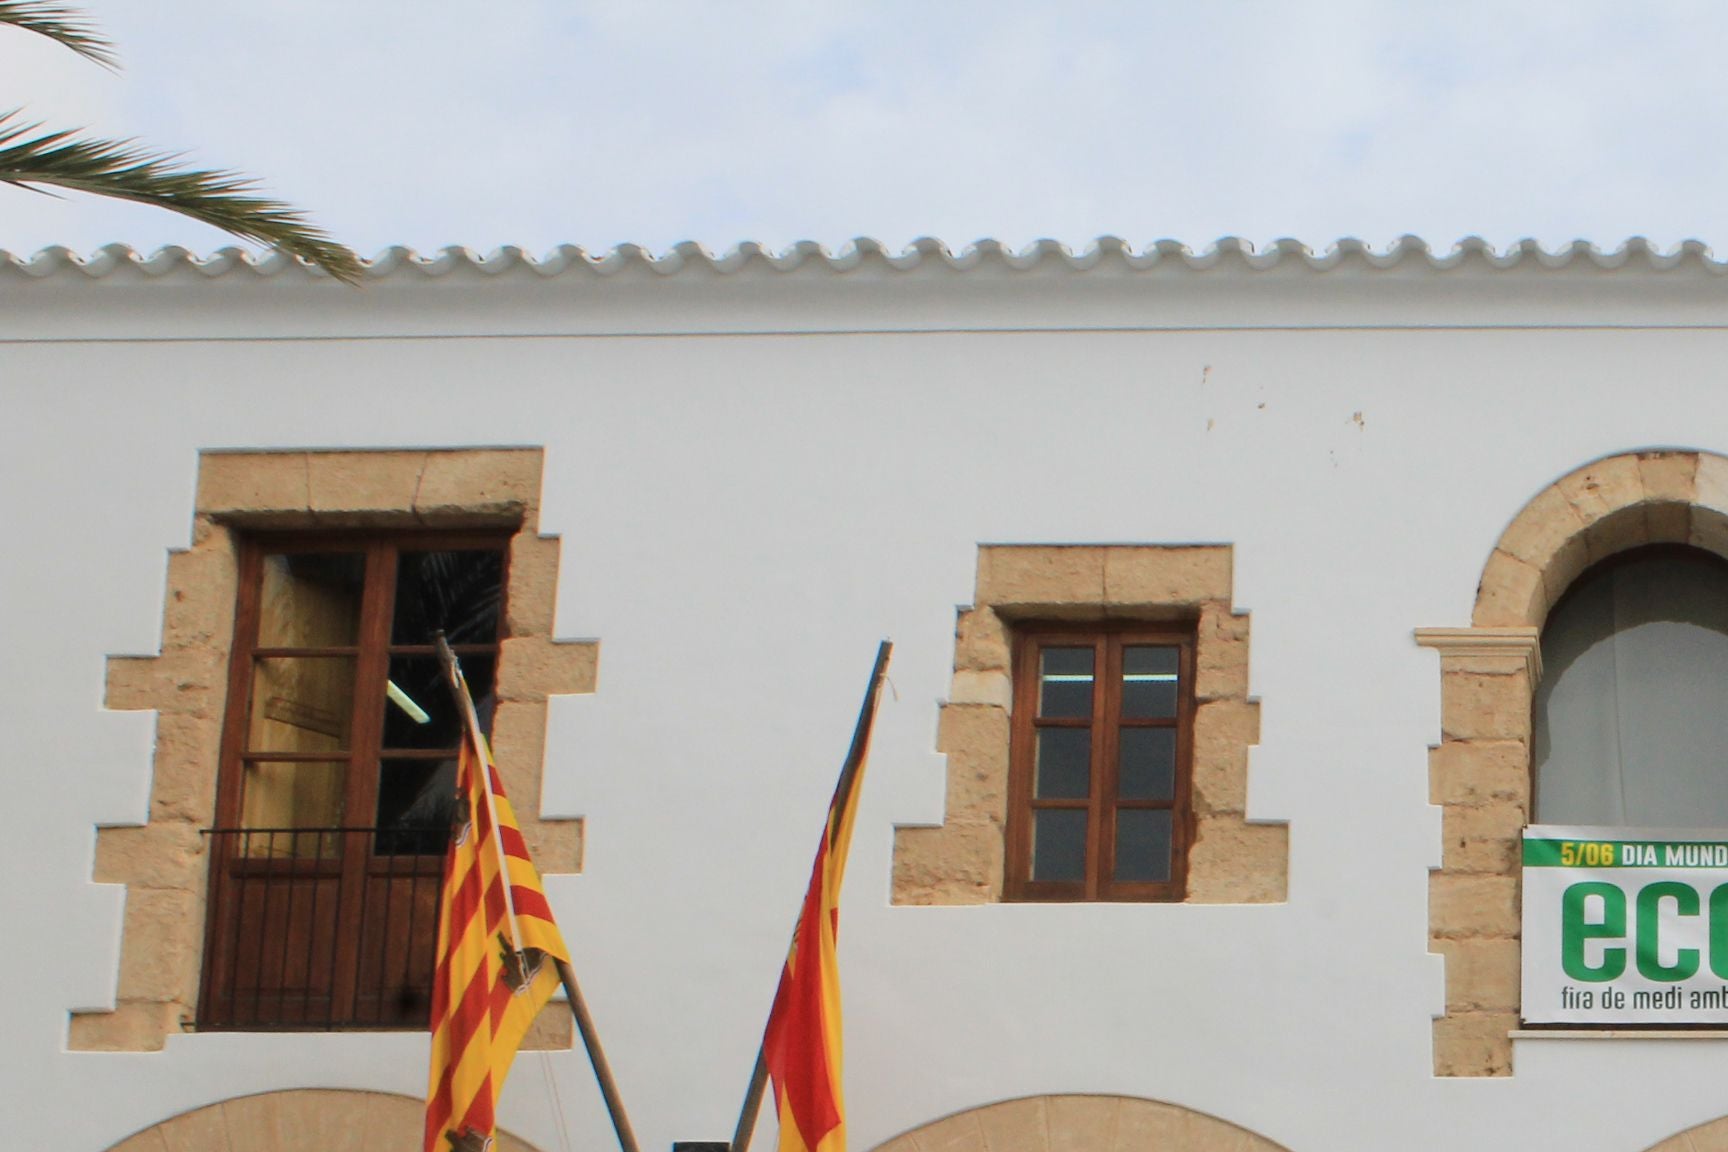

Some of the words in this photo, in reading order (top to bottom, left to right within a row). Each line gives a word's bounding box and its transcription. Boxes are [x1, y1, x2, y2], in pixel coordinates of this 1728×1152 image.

[1561, 842, 1615, 865] 5/06
[1622, 844, 1658, 865] DIA
[1561, 986, 1593, 1009] fira
[1601, 986, 1625, 1009] de
[1633, 986, 1682, 1009] medi
